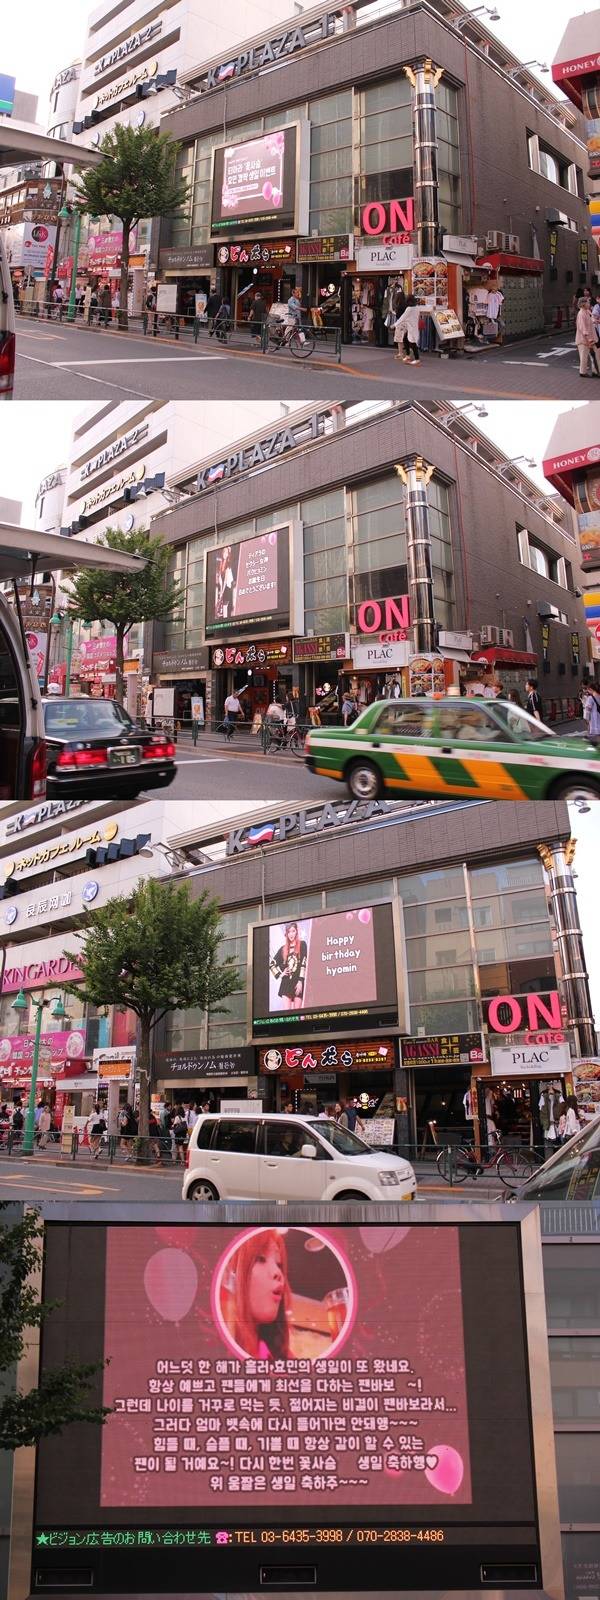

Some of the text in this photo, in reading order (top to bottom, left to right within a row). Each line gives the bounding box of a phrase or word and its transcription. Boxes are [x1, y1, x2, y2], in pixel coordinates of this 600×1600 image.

[112, 34, 142, 64] PLAZA
[207, 68, 217, 88] K
[237, 27, 306, 76] PLAZA
[562, 60, 595, 74] HONEY
[362, 197, 414, 235] ON
[370, 251, 396, 261] PLAC
[97, 437, 128, 468] PLAZA
[196, 470, 207, 491] K
[226, 427, 297, 477] PLAZA
[553, 454, 586, 469] HONEY
[358, 594, 410, 634] ON
[367, 648, 393, 660] PLAC
[14, 800, 92, 832] K PLAZ
[227, 800, 392, 856] K PLAZA
[16, 831, 102, 872] ネットカフェルーム
[326, 935, 355, 946] Happy
[321, 949, 361, 962] birthday
[326, 963, 357, 977] hyomin
[488, 992, 562, 1034] ON
[512, 1051, 550, 1064] PLAC
[157, 1360, 414, 1374] 어느덧 한 해가 흘러 효민의 생일이 또 왔네요.
[149, 1379, 175, 1393] 항상
[179, 1379, 216, 1393] 예쁘고
[221, 1379, 271, 1393] 팬들에게
[275, 1379, 312, 1393] 최선을
[316, 1379, 353, 1393] 다하는
[358, 1379, 395, 1393] 팬바보
[115, 1398, 152, 1412] 그런데
[156, 1399, 194, 1412] 나이를
[198, 1399, 236, 1412] 거꾸로
[240, 1398, 265, 1412] 먹는
[289, 1398, 338, 1412] 젊어지는
[342, 1398, 379, 1412] 비결이
[383, 1398, 457, 1412] 팬바보라서...
[153, 1418, 192, 1432] 그러다
[195, 1418, 222, 1431] 엄마
[226, 1417, 263, 1431] 뱃속에
[268, 1417, 292, 1431] 다시
[296, 1417, 346, 1431] 들어가면
[153, 1436, 424, 1451] 힘들 때, 슬플 때, 기쁠 때 항상 같이 할 수 있는
[134, 1457, 160, 1471] 팬이
[164, 1457, 177, 1471] 될
[181, 1456, 234, 1471] 거예요~!
[239, 1456, 264, 1471] 다시
[268, 1456, 294, 1470] 한번
[299, 1456, 337, 1471] 꽃사슴
[357, 1455, 383, 1470] 생일
[210, 1475, 368, 1490] 위 움짤은 생일 축하주~~~
[235, 1532, 257, 1543] TEL
[260, 1530, 343, 1543] 03-6435-3998
[356, 1530, 445, 1542] 070-2838-4486
